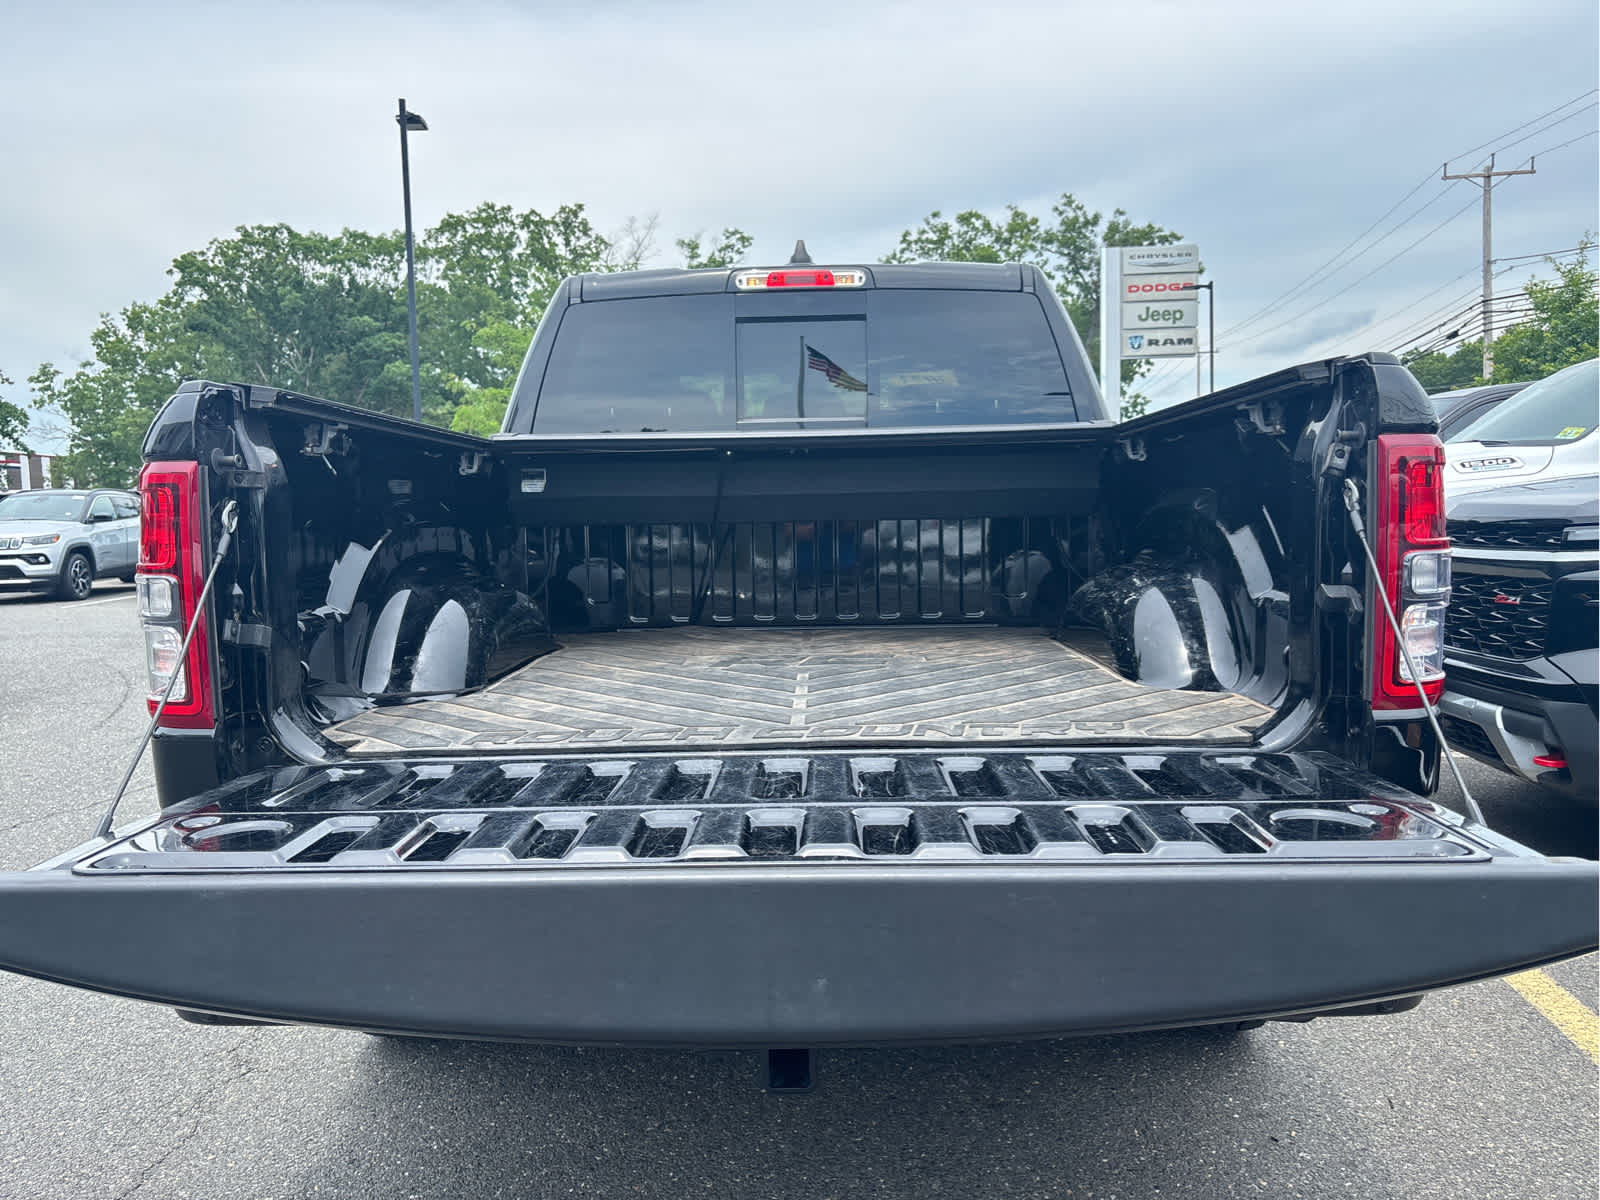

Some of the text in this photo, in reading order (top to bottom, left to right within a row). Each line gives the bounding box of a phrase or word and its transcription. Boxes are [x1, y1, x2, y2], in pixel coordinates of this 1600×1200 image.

[1129, 252, 1192, 260] CHRYSLER
[1137, 306, 1184, 324] Jeep
[1147, 338, 1193, 346] RAM
[1462, 458, 1514, 468] 1500
[752, 721, 1125, 739] COUNTRY
